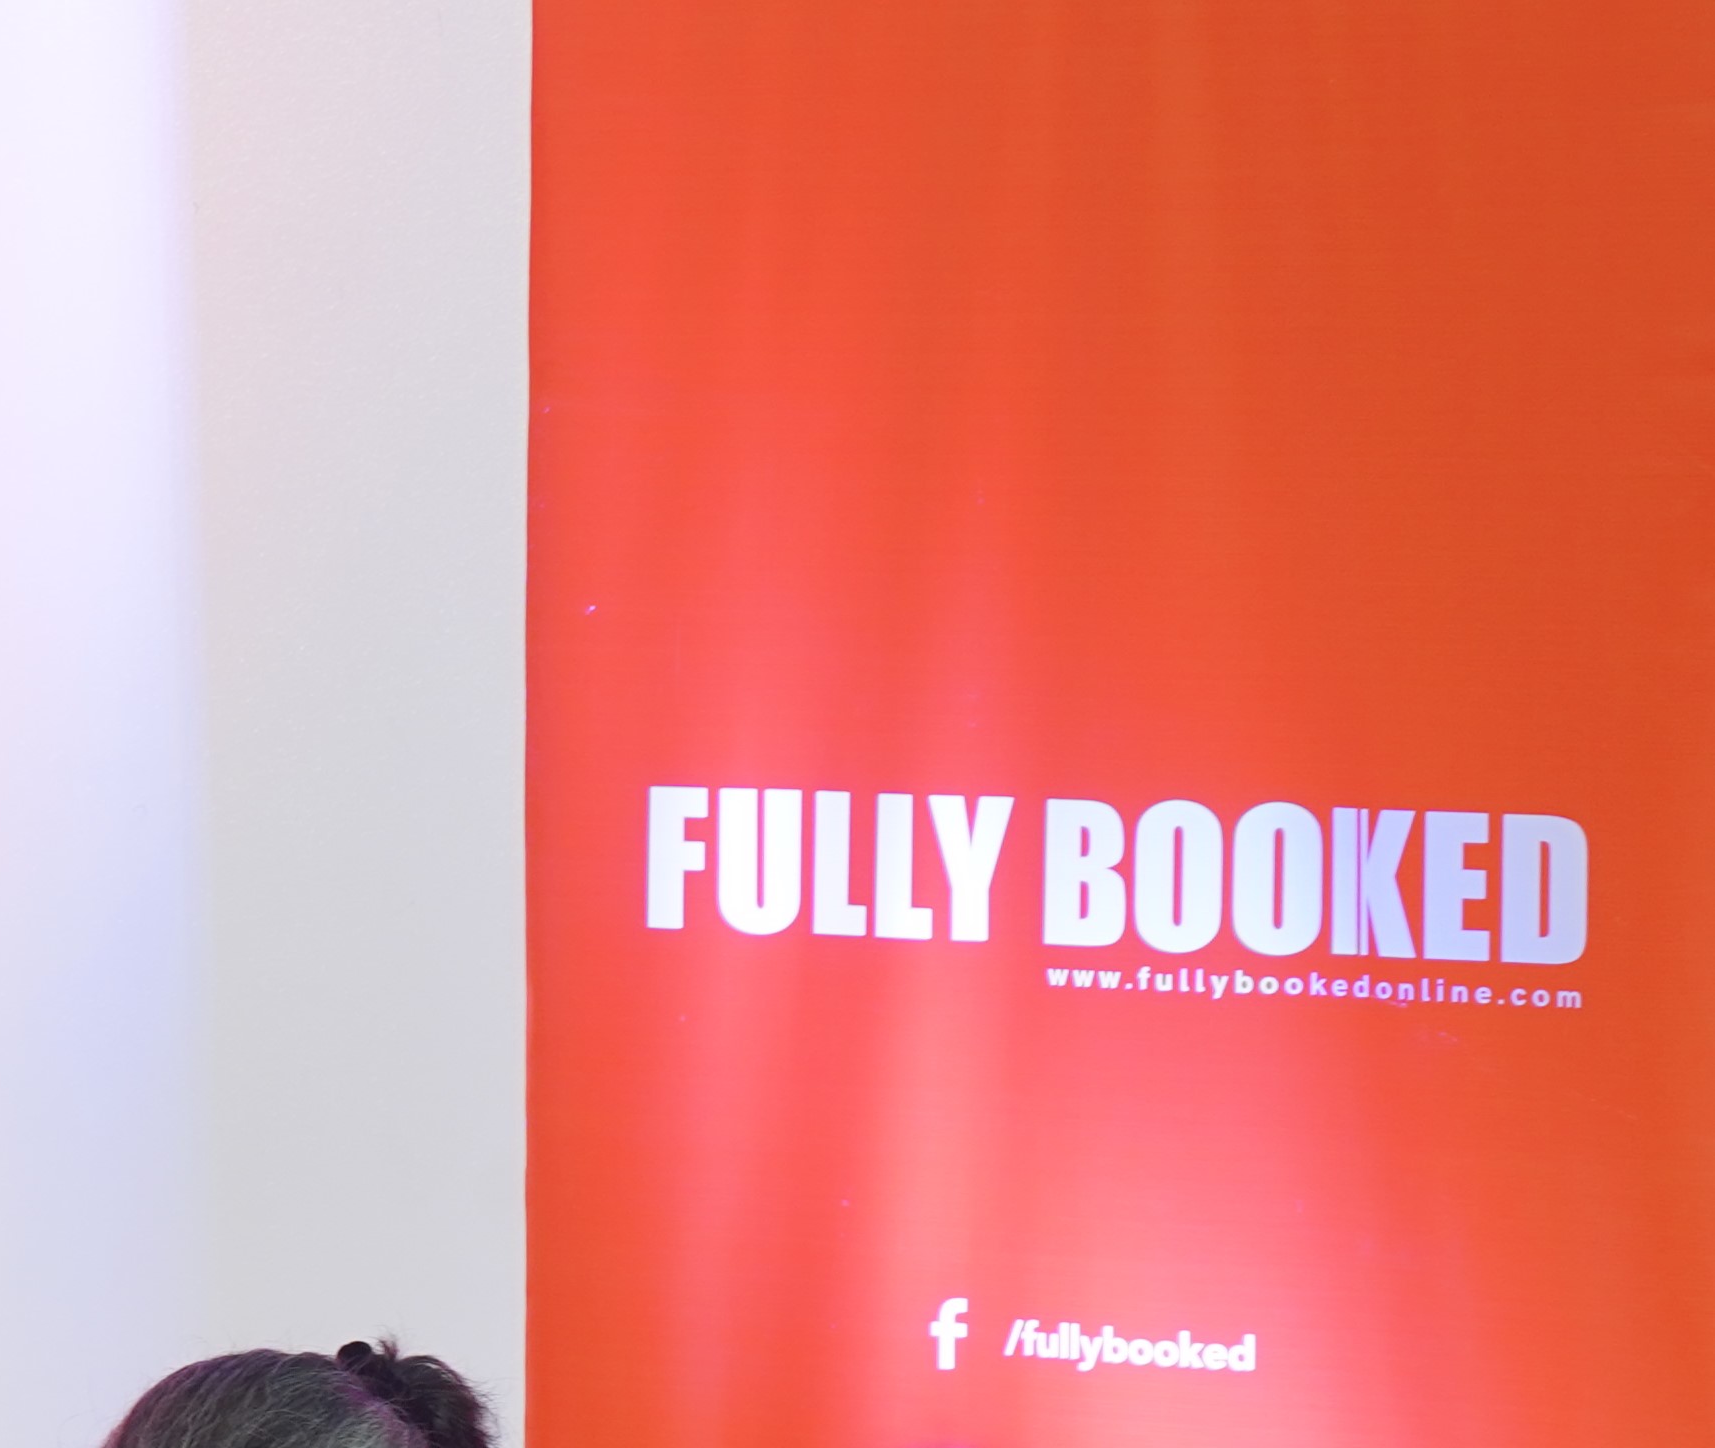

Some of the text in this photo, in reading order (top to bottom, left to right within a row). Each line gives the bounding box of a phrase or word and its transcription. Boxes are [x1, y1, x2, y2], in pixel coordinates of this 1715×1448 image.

[645, 785, 1589, 966] FULLY BOOKED
[1046, 964, 1584, 1009] www.fullybookedonline.com
[1003, 1318, 1257, 1372] /fullybooked
